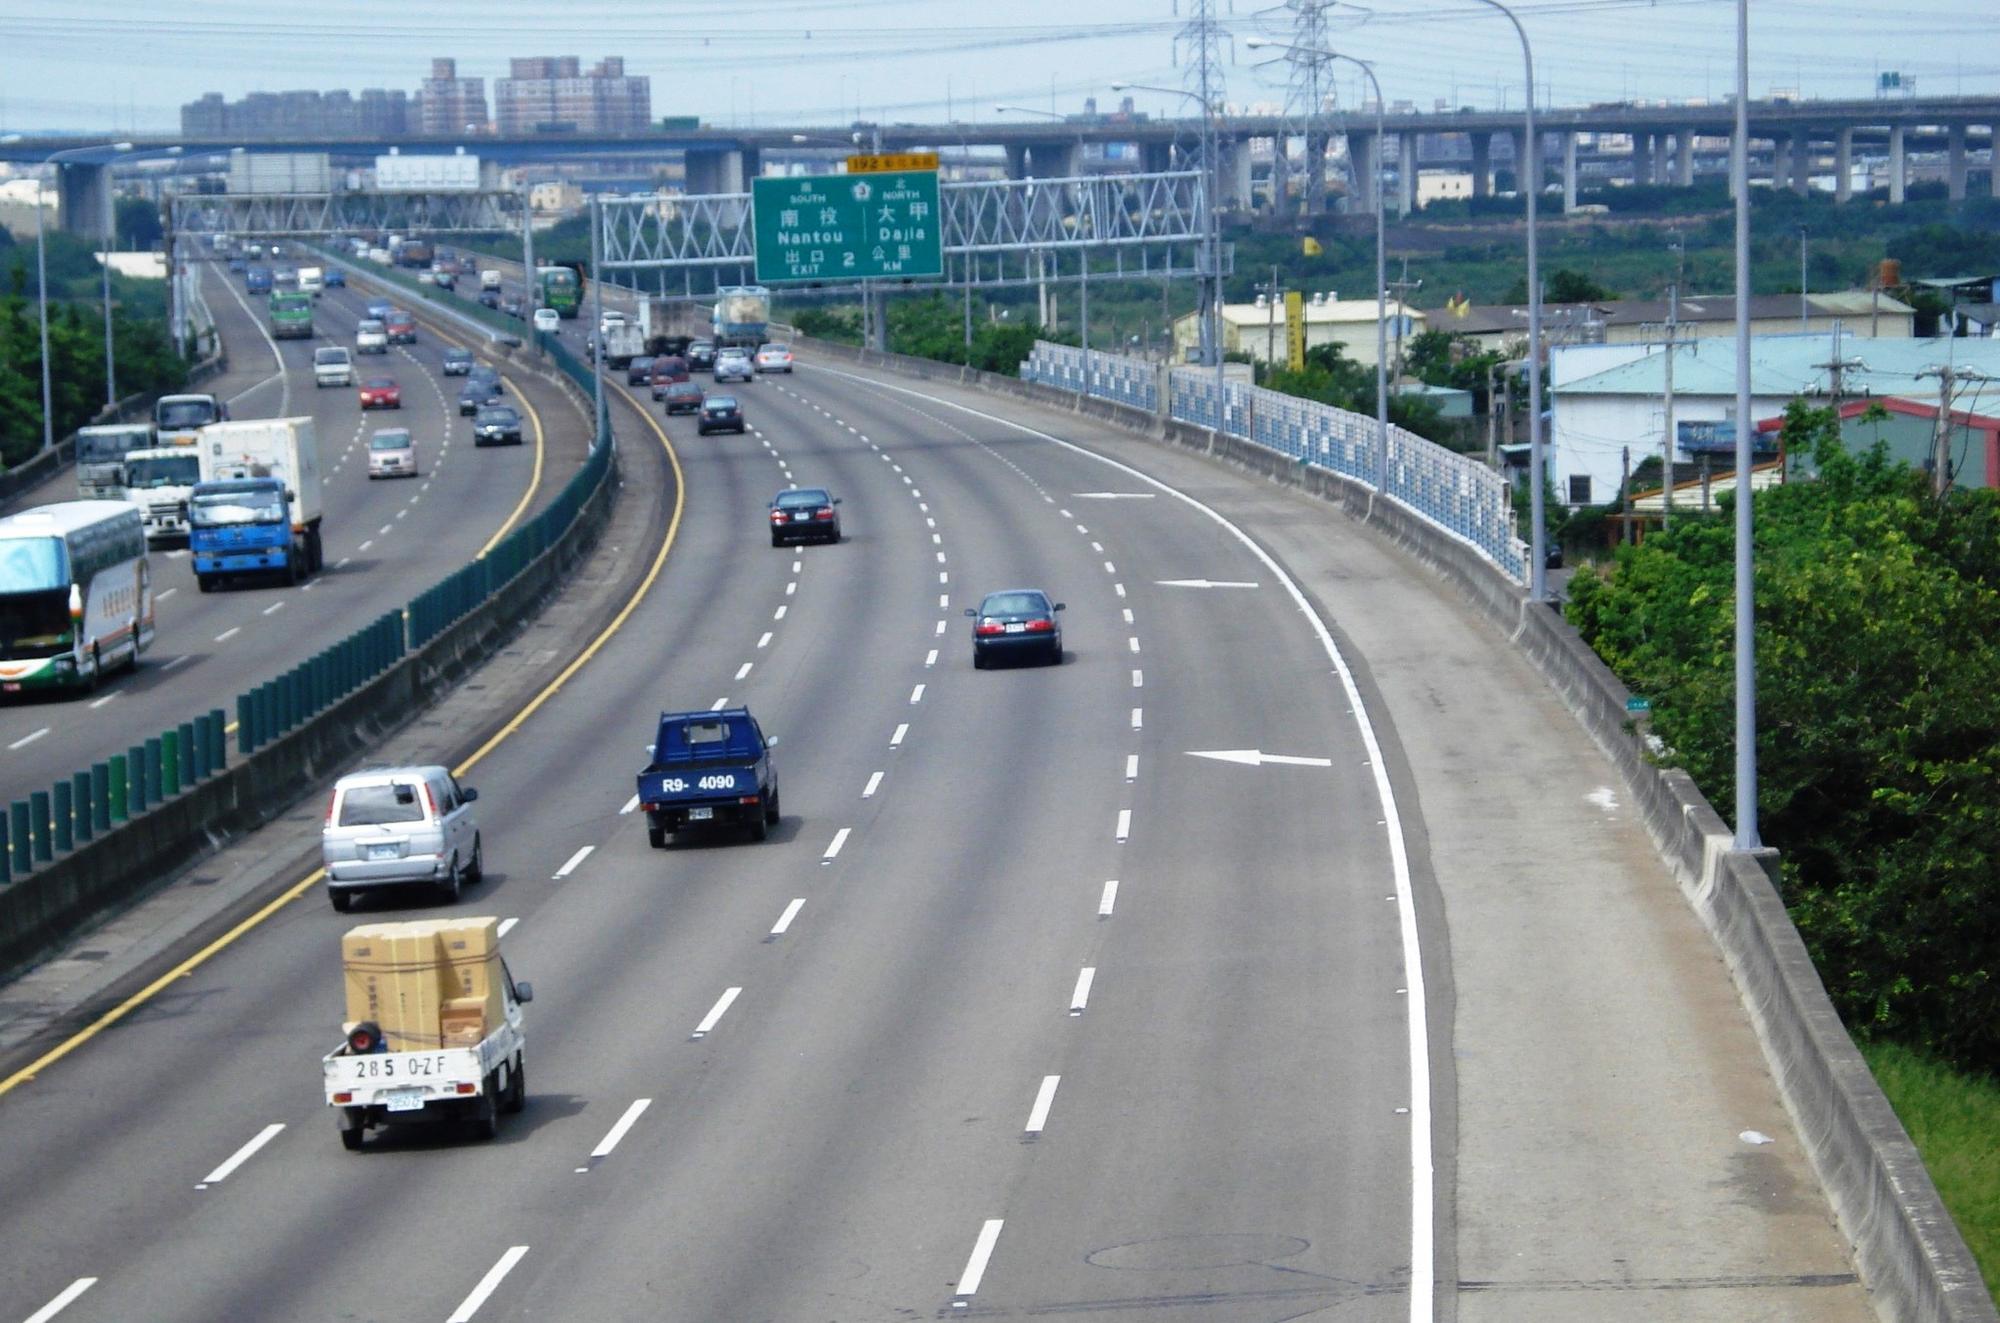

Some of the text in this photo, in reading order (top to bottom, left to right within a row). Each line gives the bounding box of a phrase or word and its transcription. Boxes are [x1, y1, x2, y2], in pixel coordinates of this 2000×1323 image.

[790, 194, 826, 204] SOUTH
[882, 190, 920, 200] NORTH
[780, 206, 837, 228] 南投
[878, 202, 928, 223] 大甲
[778, 230, 843, 245] Nantou
[879, 227, 925, 242] Dajia
[785, 249, 824, 264] 出口
[843, 252, 855, 268] 2
[883, 261, 902, 271] KM
[791, 264, 820, 275] EXIT
[662, 774, 735, 792] R9- 4090
[356, 1059, 394, 1078] 285
